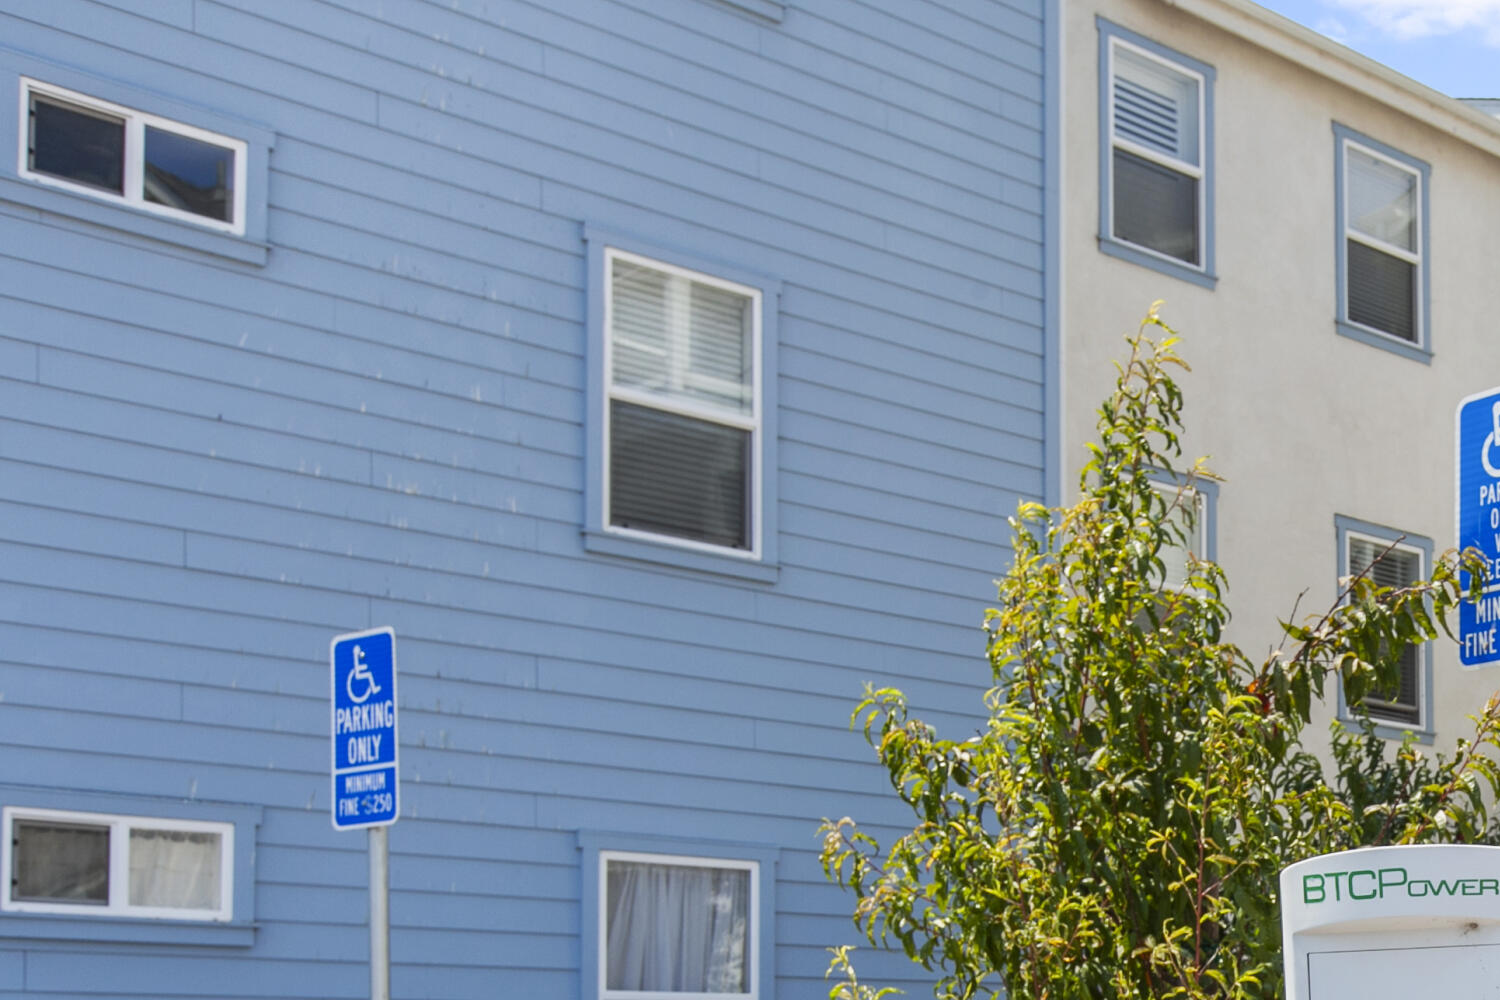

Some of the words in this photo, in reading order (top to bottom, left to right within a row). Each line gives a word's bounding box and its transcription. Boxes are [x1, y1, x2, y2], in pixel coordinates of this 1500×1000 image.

[1465, 628, 1497, 658] FINE
[337, 700, 393, 734] PARKING
[348, 734, 382, 764] ONLY
[345, 771, 386, 794] MINIMUM
[339, 796, 360, 817] FINE
[364, 792, 392, 815] $250
